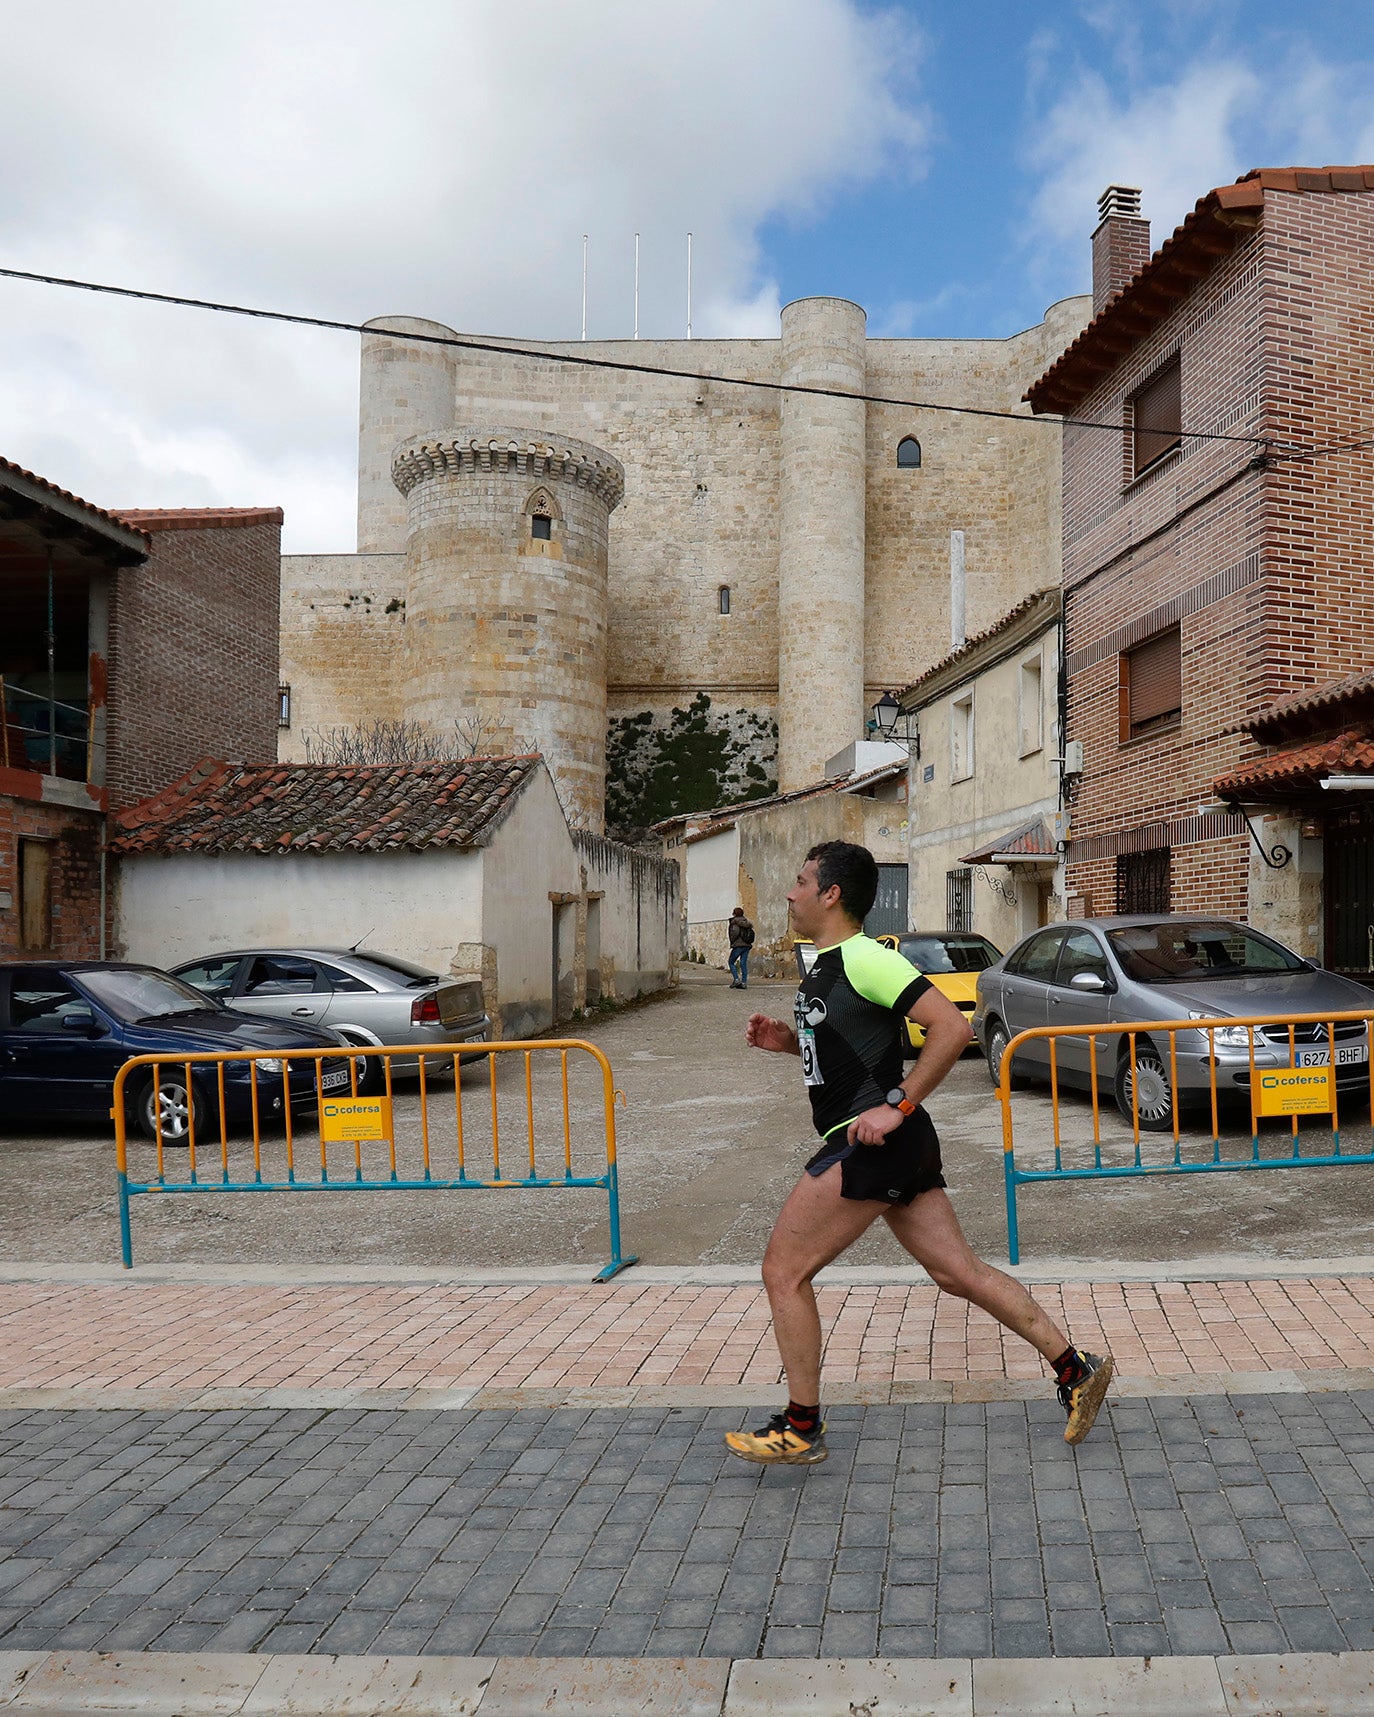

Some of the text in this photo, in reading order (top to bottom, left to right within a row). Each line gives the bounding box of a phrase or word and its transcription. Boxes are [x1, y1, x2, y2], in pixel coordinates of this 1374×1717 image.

[1339, 1048, 1360, 1063] BHF
[1281, 1075, 1327, 1085] cofersa
[340, 1105, 380, 1114] cofersa
